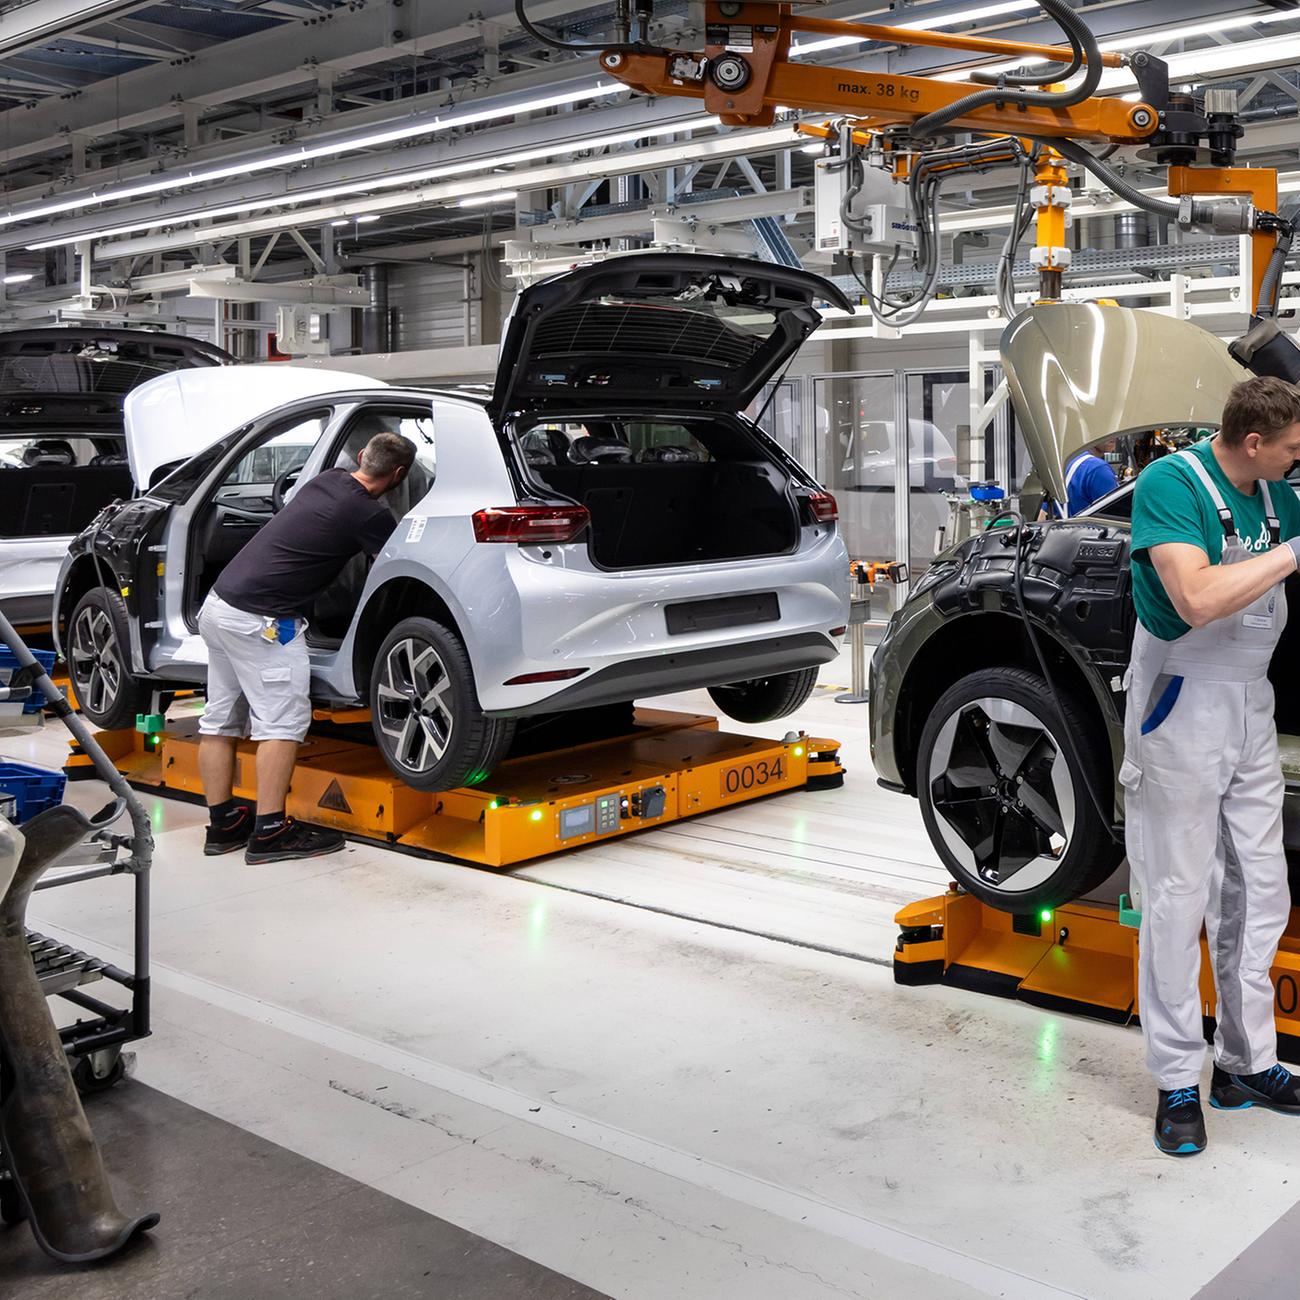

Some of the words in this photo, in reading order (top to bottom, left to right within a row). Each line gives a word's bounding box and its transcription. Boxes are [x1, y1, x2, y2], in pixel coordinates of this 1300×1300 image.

[838, 83, 871, 95] max.
[876, 83, 895, 97] 38
[900, 85, 920, 103] kg
[726, 757, 783, 793] 0034
